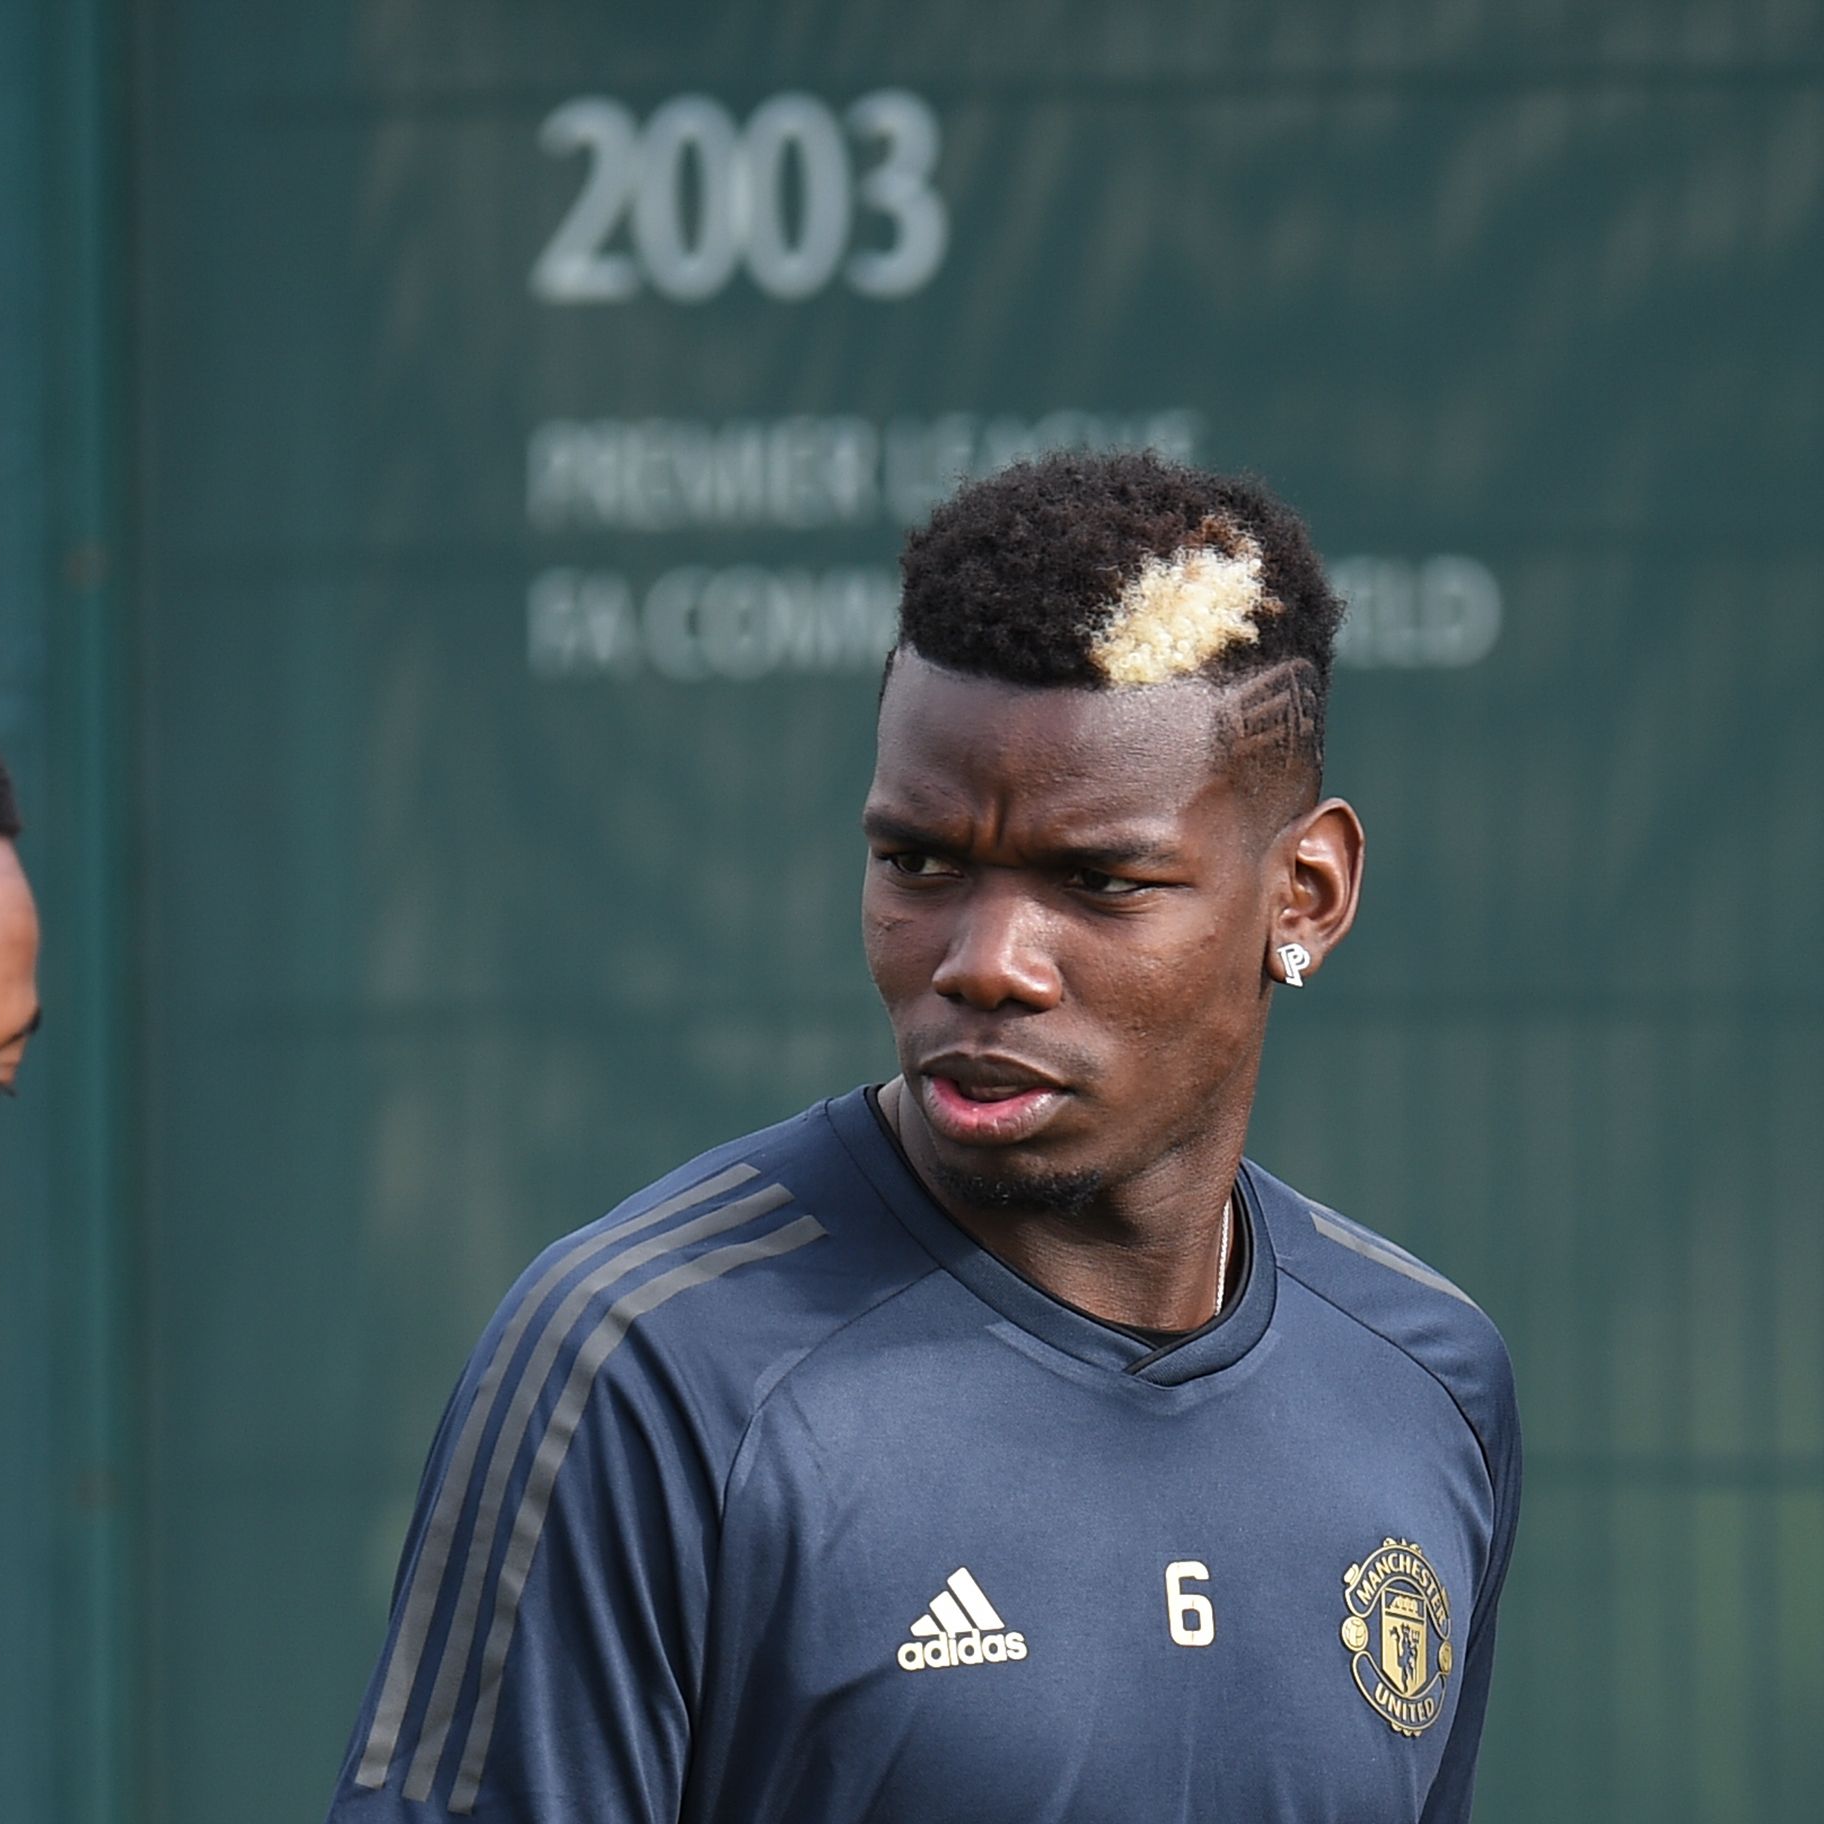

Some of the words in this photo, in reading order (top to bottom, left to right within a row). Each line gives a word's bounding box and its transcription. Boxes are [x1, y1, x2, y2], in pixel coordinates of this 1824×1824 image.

[531, 90, 949, 303] 2003
[527, 415, 879, 527] PREMIER
[1164, 1560, 1216, 1648] 6
[1356, 1553, 1447, 1627] MANCHESTER
[896, 1629, 1029, 1672] adidas
[1374, 1682, 1435, 1722] UNITED
